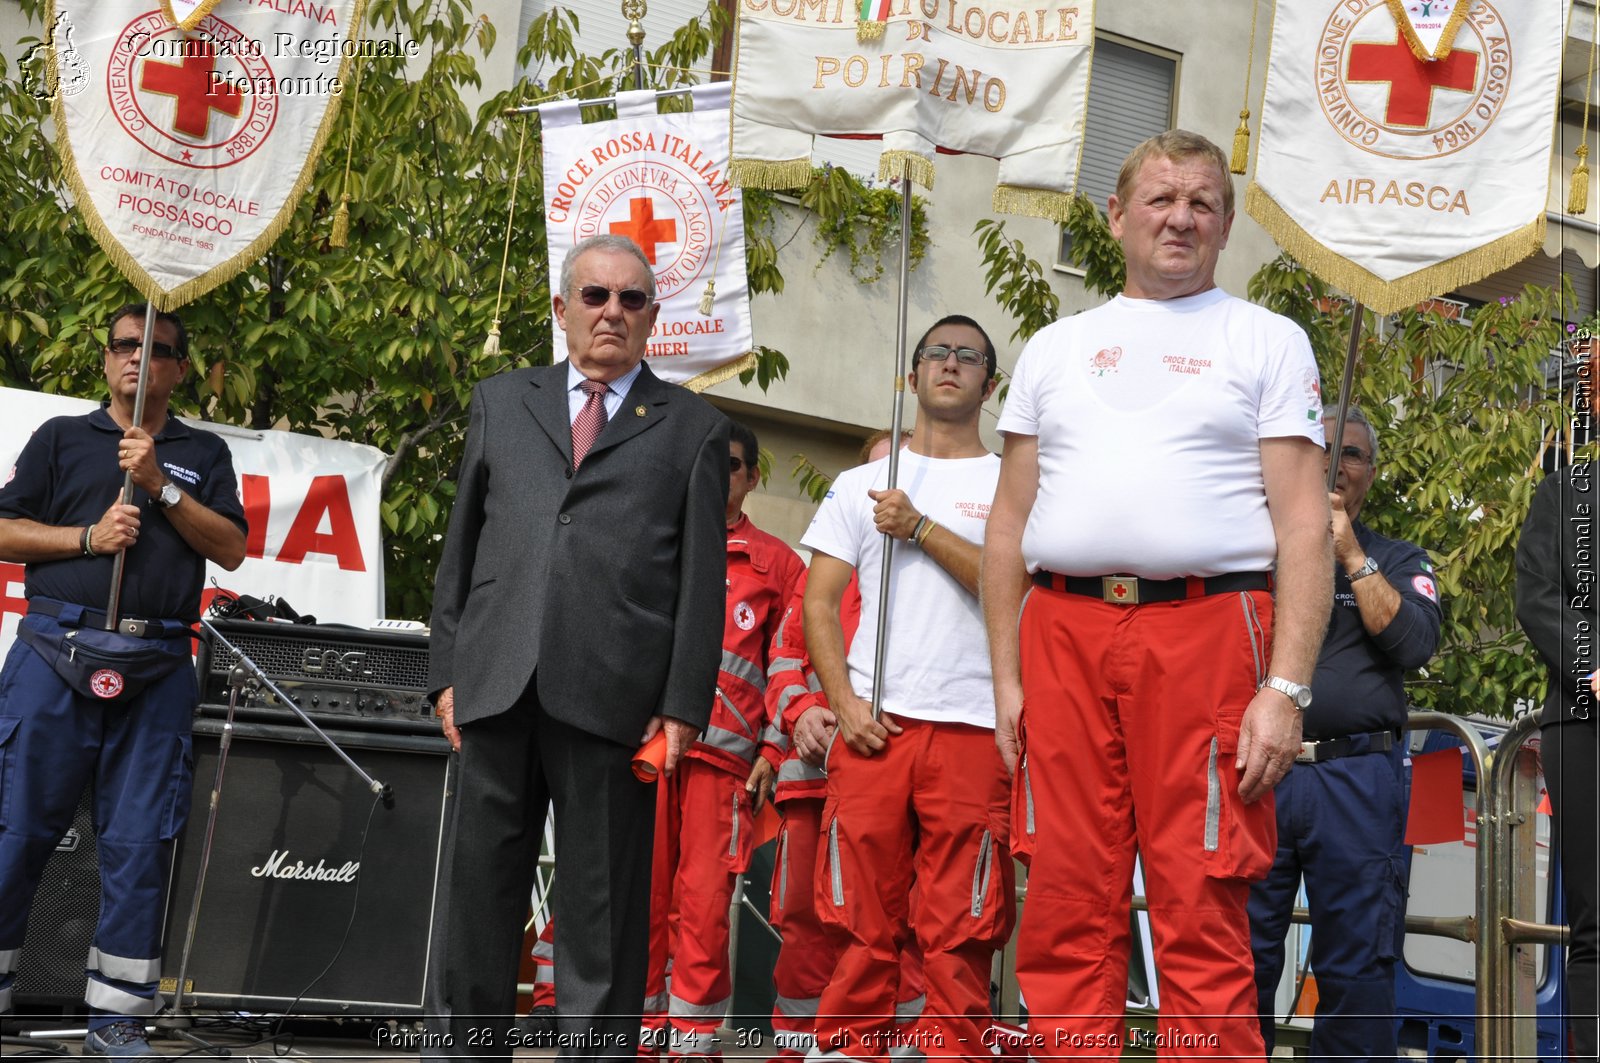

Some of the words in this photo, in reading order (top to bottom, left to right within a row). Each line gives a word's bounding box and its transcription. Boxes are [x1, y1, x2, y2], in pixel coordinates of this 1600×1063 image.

[906, 19, 932, 42] DI
[946, 0, 1079, 45] LOCALE
[1469, 4, 1496, 30] 22
[112, 22, 148, 132] CONVENZIONE
[149, 14, 167, 31] DI
[226, 134, 256, 159] 1864
[812, 52, 1007, 113] POIRINO
[1320, 15, 1379, 146] CONVENZIONE
[1475, 36, 1508, 120] AGOSTO
[1432, 120, 1477, 152] 1864
[548, 158, 593, 223] CROCE
[591, 131, 656, 165] ROSSA
[661, 134, 737, 212] ITALIANA
[613, 167, 678, 194] GINEVRA
[100, 166, 190, 199] COMITATO
[193, 188, 260, 216] LOCALE
[595, 183, 615, 203] DI
[678, 190, 698, 210] 22
[1319, 178, 1471, 216] AIRASCA
[118, 193, 233, 236] PIOSSASCO
[132, 224, 177, 242] FONDATO
[177, 236, 194, 246] NEL
[196, 240, 214, 251] 1983
[680, 211, 707, 272] AGOSTO
[655, 267, 686, 294] 1864
[662, 318, 725, 337] LOCALE
[645, 341, 689, 357] HIERI
[1162, 355, 1186, 365] CROCE
[1188, 358, 1212, 368] ROSSA
[1168, 364, 1201, 375] ITALIANA
[163, 462, 185, 474] CROCE
[170, 469, 196, 485] ITALIANA
[955, 502, 975, 510] CROCE
[302, 648, 373, 676] ENGL
[251, 849, 360, 882] Marshall
